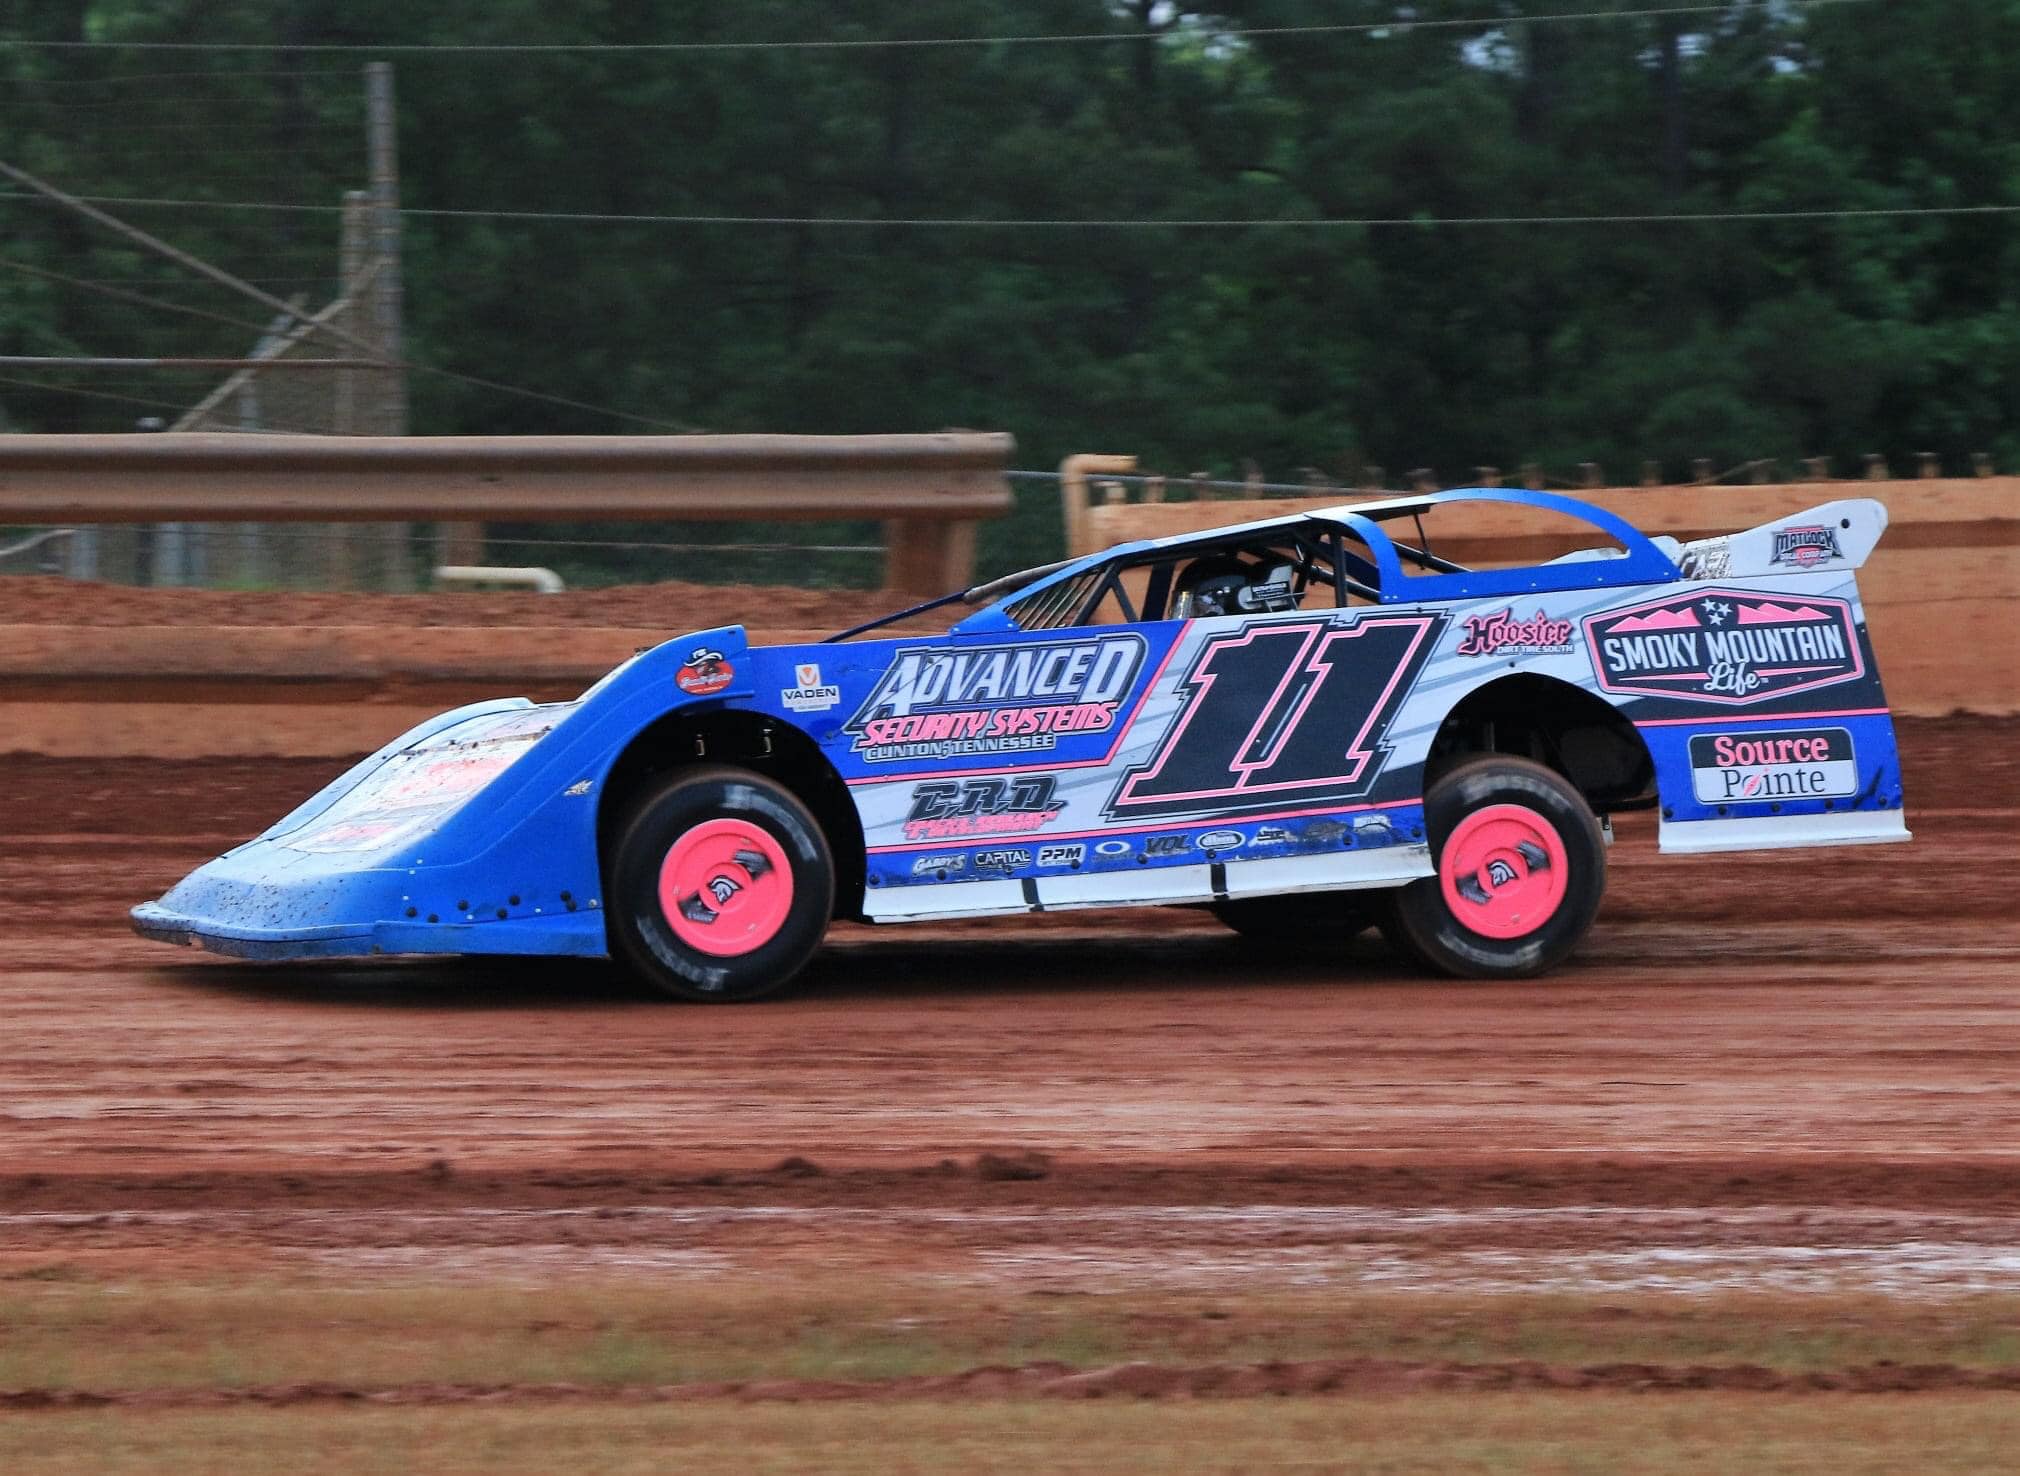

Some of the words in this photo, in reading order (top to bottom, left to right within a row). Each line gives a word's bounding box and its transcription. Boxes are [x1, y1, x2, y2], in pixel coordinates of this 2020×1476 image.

[1775, 529, 1842, 558] MATLOCK
[1457, 607, 1575, 656] Hoosier
[1604, 632, 1700, 672] SMOKY
[1703, 624, 1847, 666] MOUNTAIN
[784, 687, 837, 700] VADEN
[860, 637, 1143, 722] ADVANCED
[1703, 661, 1761, 696] Life
[858, 710, 992, 746] SECURITY
[987, 701, 1119, 736] SYSTEMS
[1105, 612, 1442, 812] 11
[952, 734, 1055, 754] TENNESSEE
[1714, 736, 1829, 767] Source
[1721, 767, 1825, 797] Pointe
[975, 850, 1032, 866] CAPITAL
[1040, 846, 1082, 861] PPM
